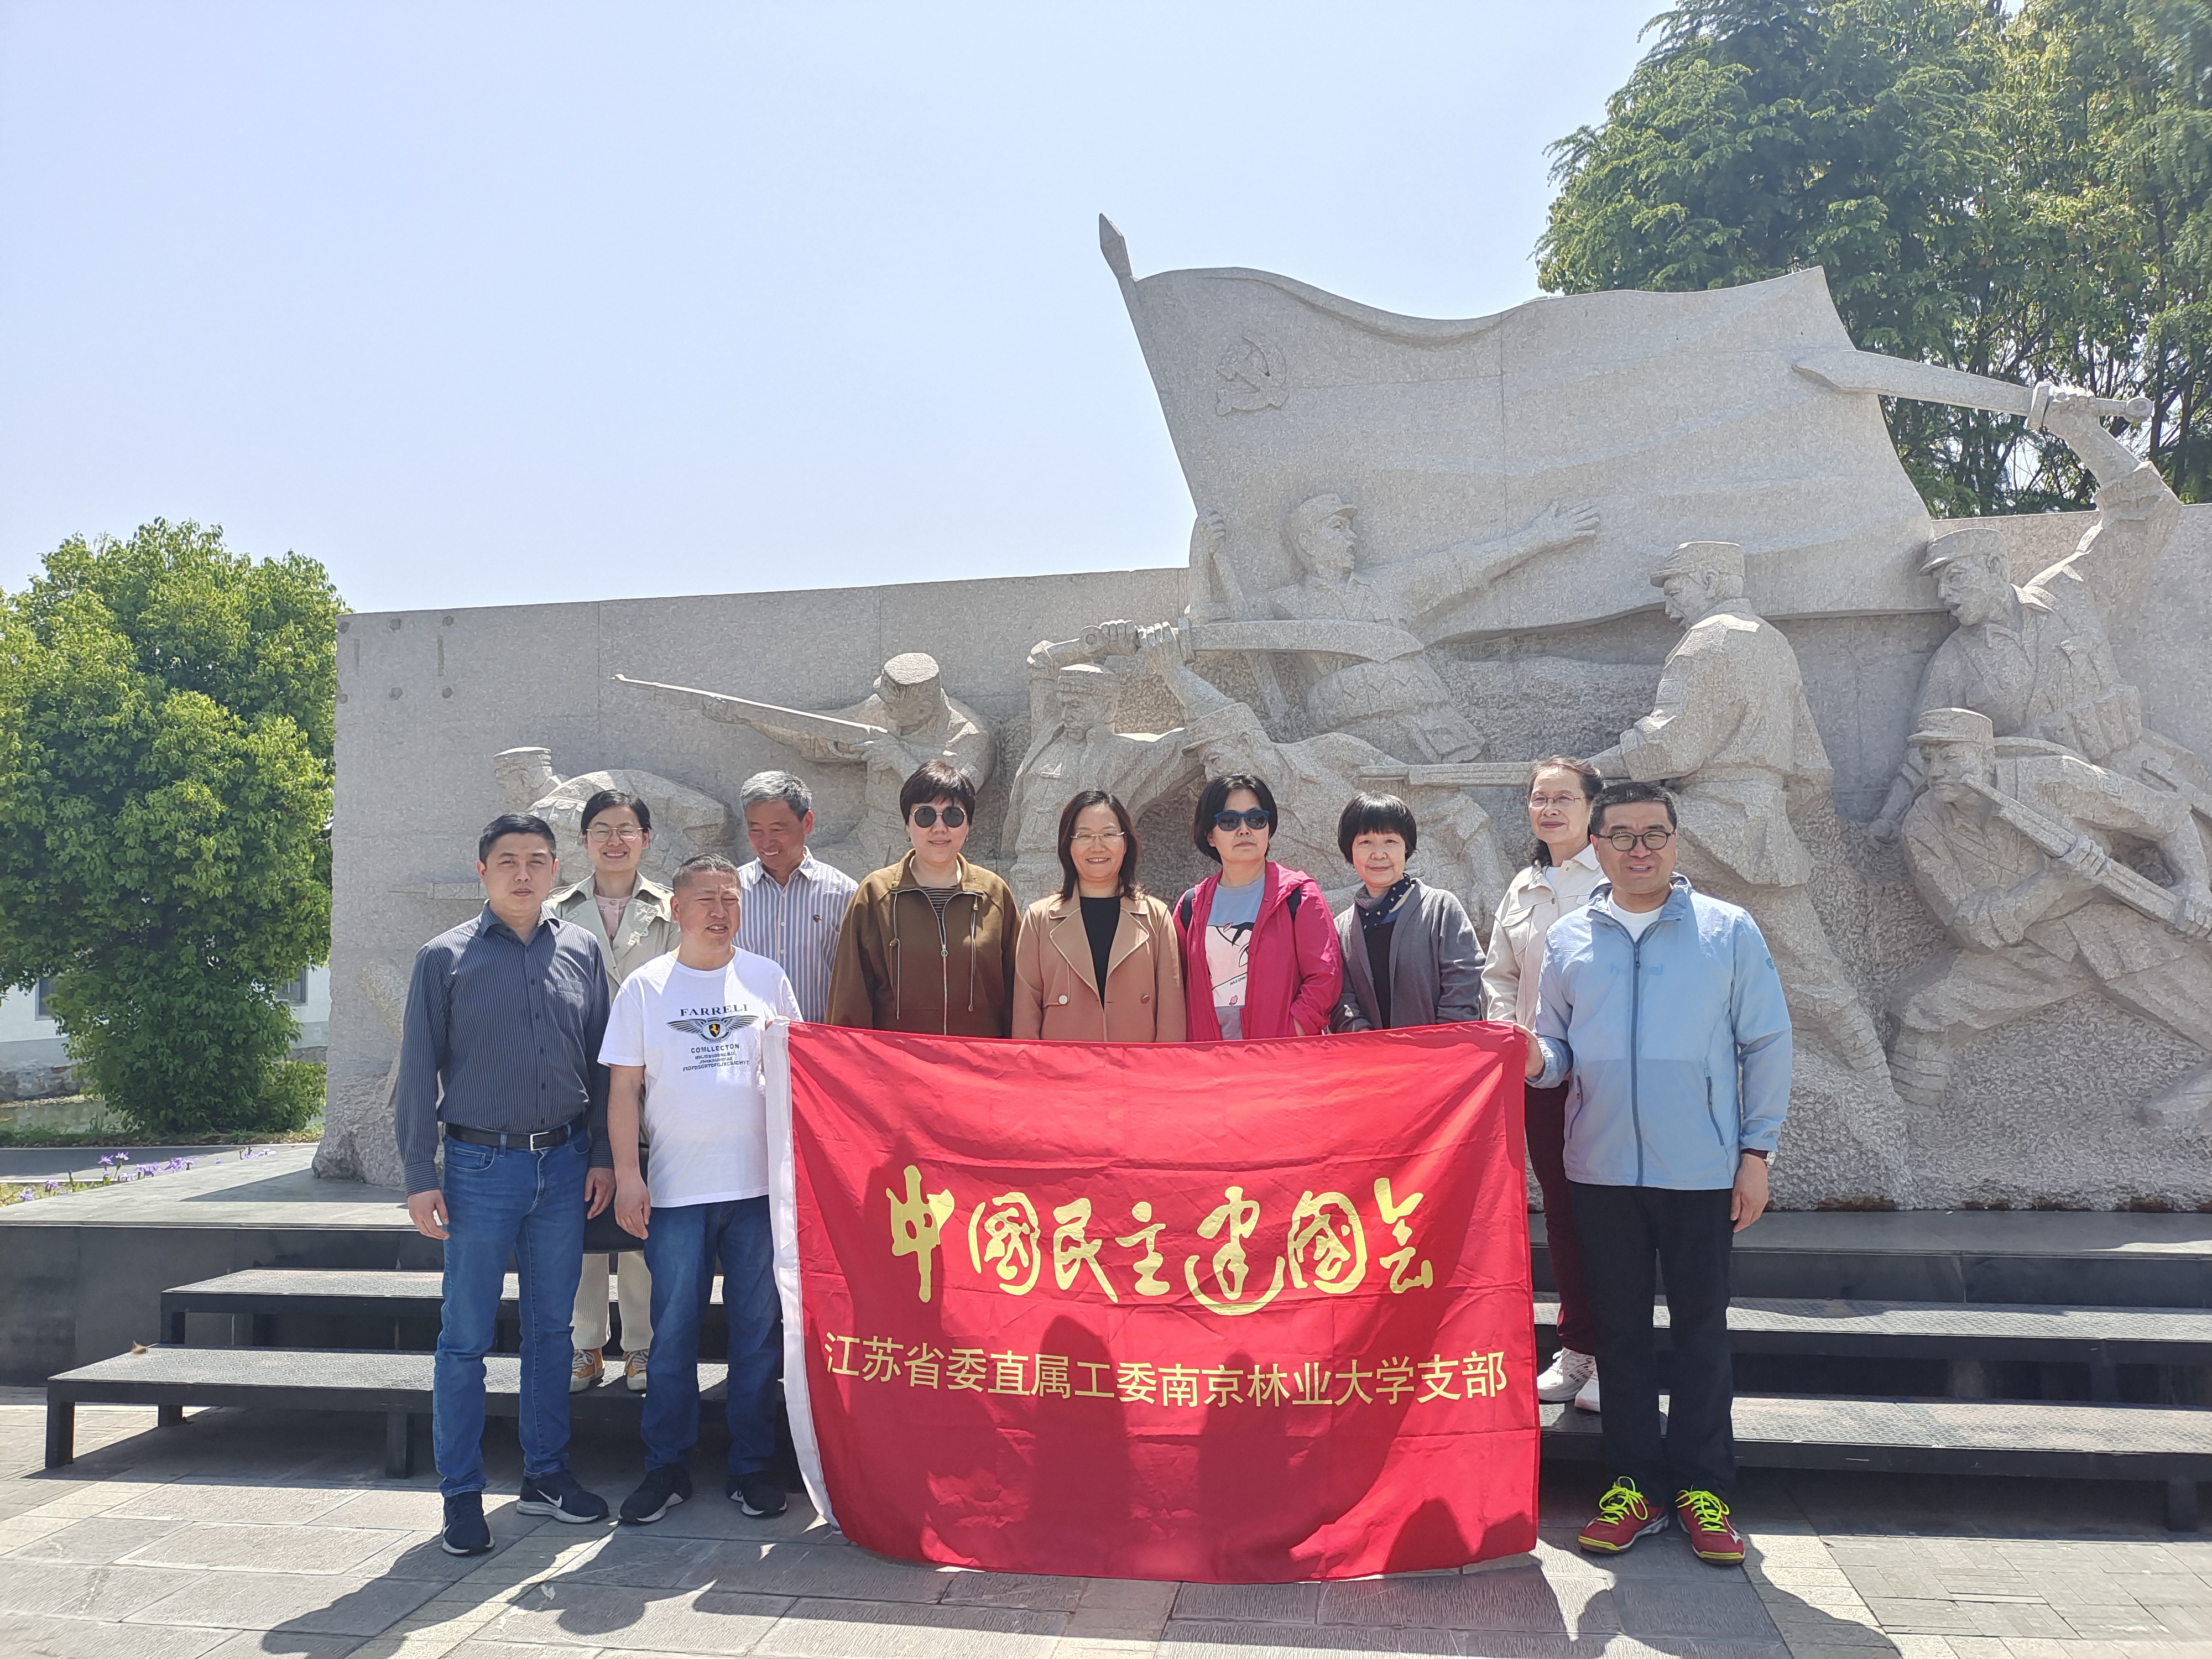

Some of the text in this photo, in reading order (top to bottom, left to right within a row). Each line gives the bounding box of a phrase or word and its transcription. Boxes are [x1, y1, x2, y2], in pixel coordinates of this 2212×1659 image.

[824, 1331, 1507, 1407] 江苏省委直属工委南京林业大学支部
